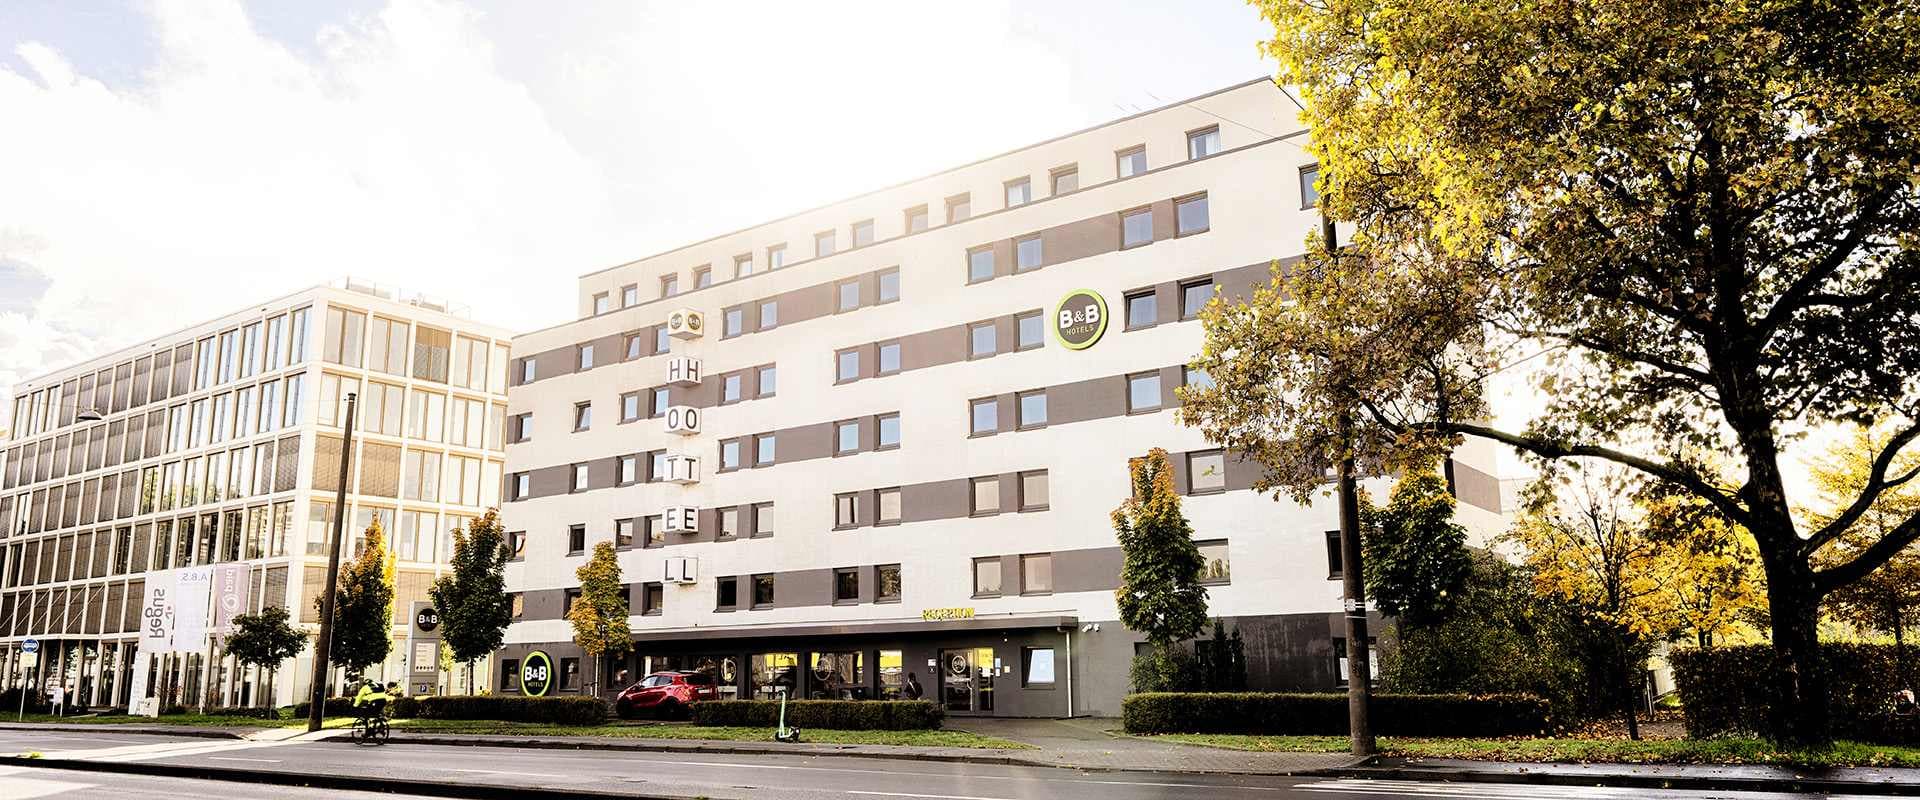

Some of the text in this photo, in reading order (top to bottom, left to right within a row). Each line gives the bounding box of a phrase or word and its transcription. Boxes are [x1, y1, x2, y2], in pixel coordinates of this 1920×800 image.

[1060, 304, 1099, 328] B&B
[1066, 325, 1094, 336] HOTELS
[683, 359, 698, 580] HOTEL
[418, 615, 438, 624] B&B
[525, 666, 547, 681] B&B
